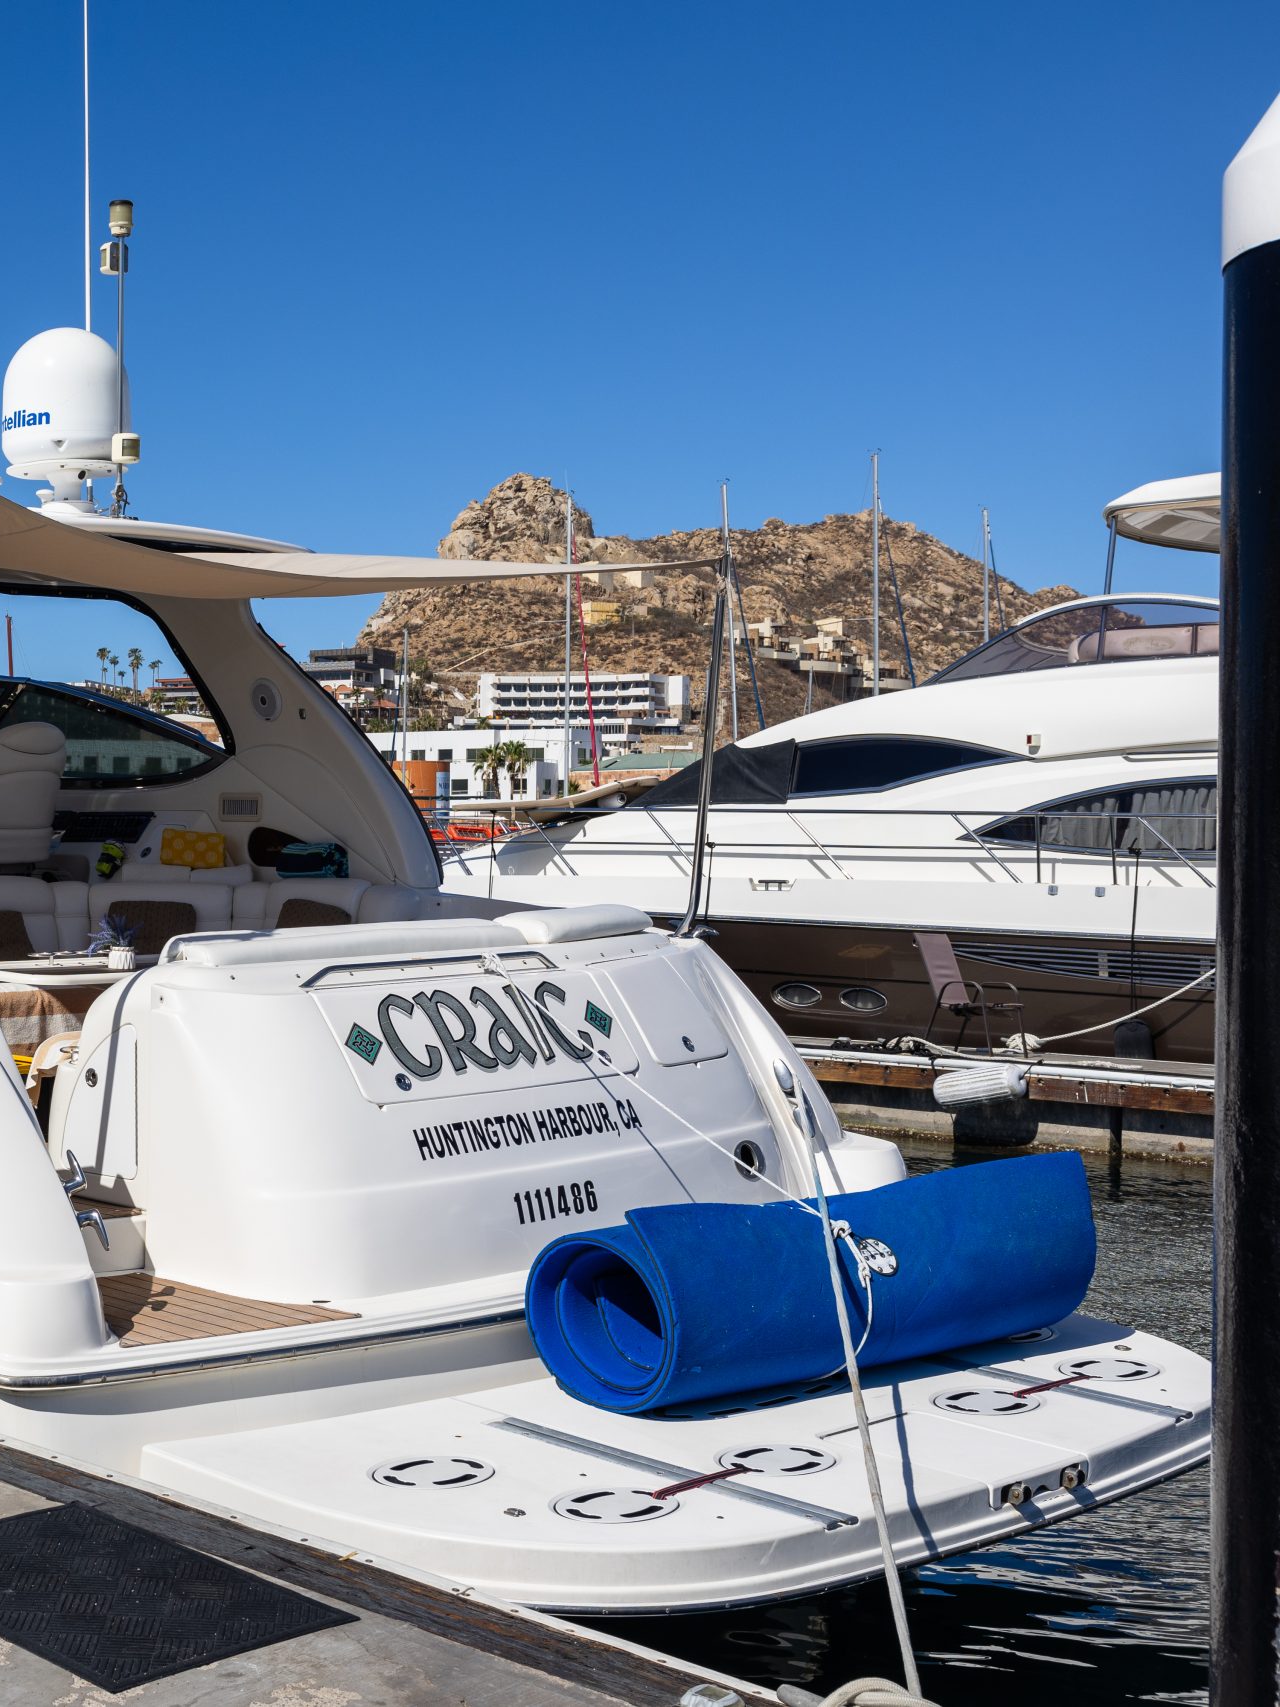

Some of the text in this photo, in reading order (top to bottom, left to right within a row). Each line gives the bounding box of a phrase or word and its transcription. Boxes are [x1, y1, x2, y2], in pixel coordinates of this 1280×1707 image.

[412, 1098, 643, 1161] HUNTINGTON HARBOUR, CA
[514, 1180, 598, 1225] 1111486
